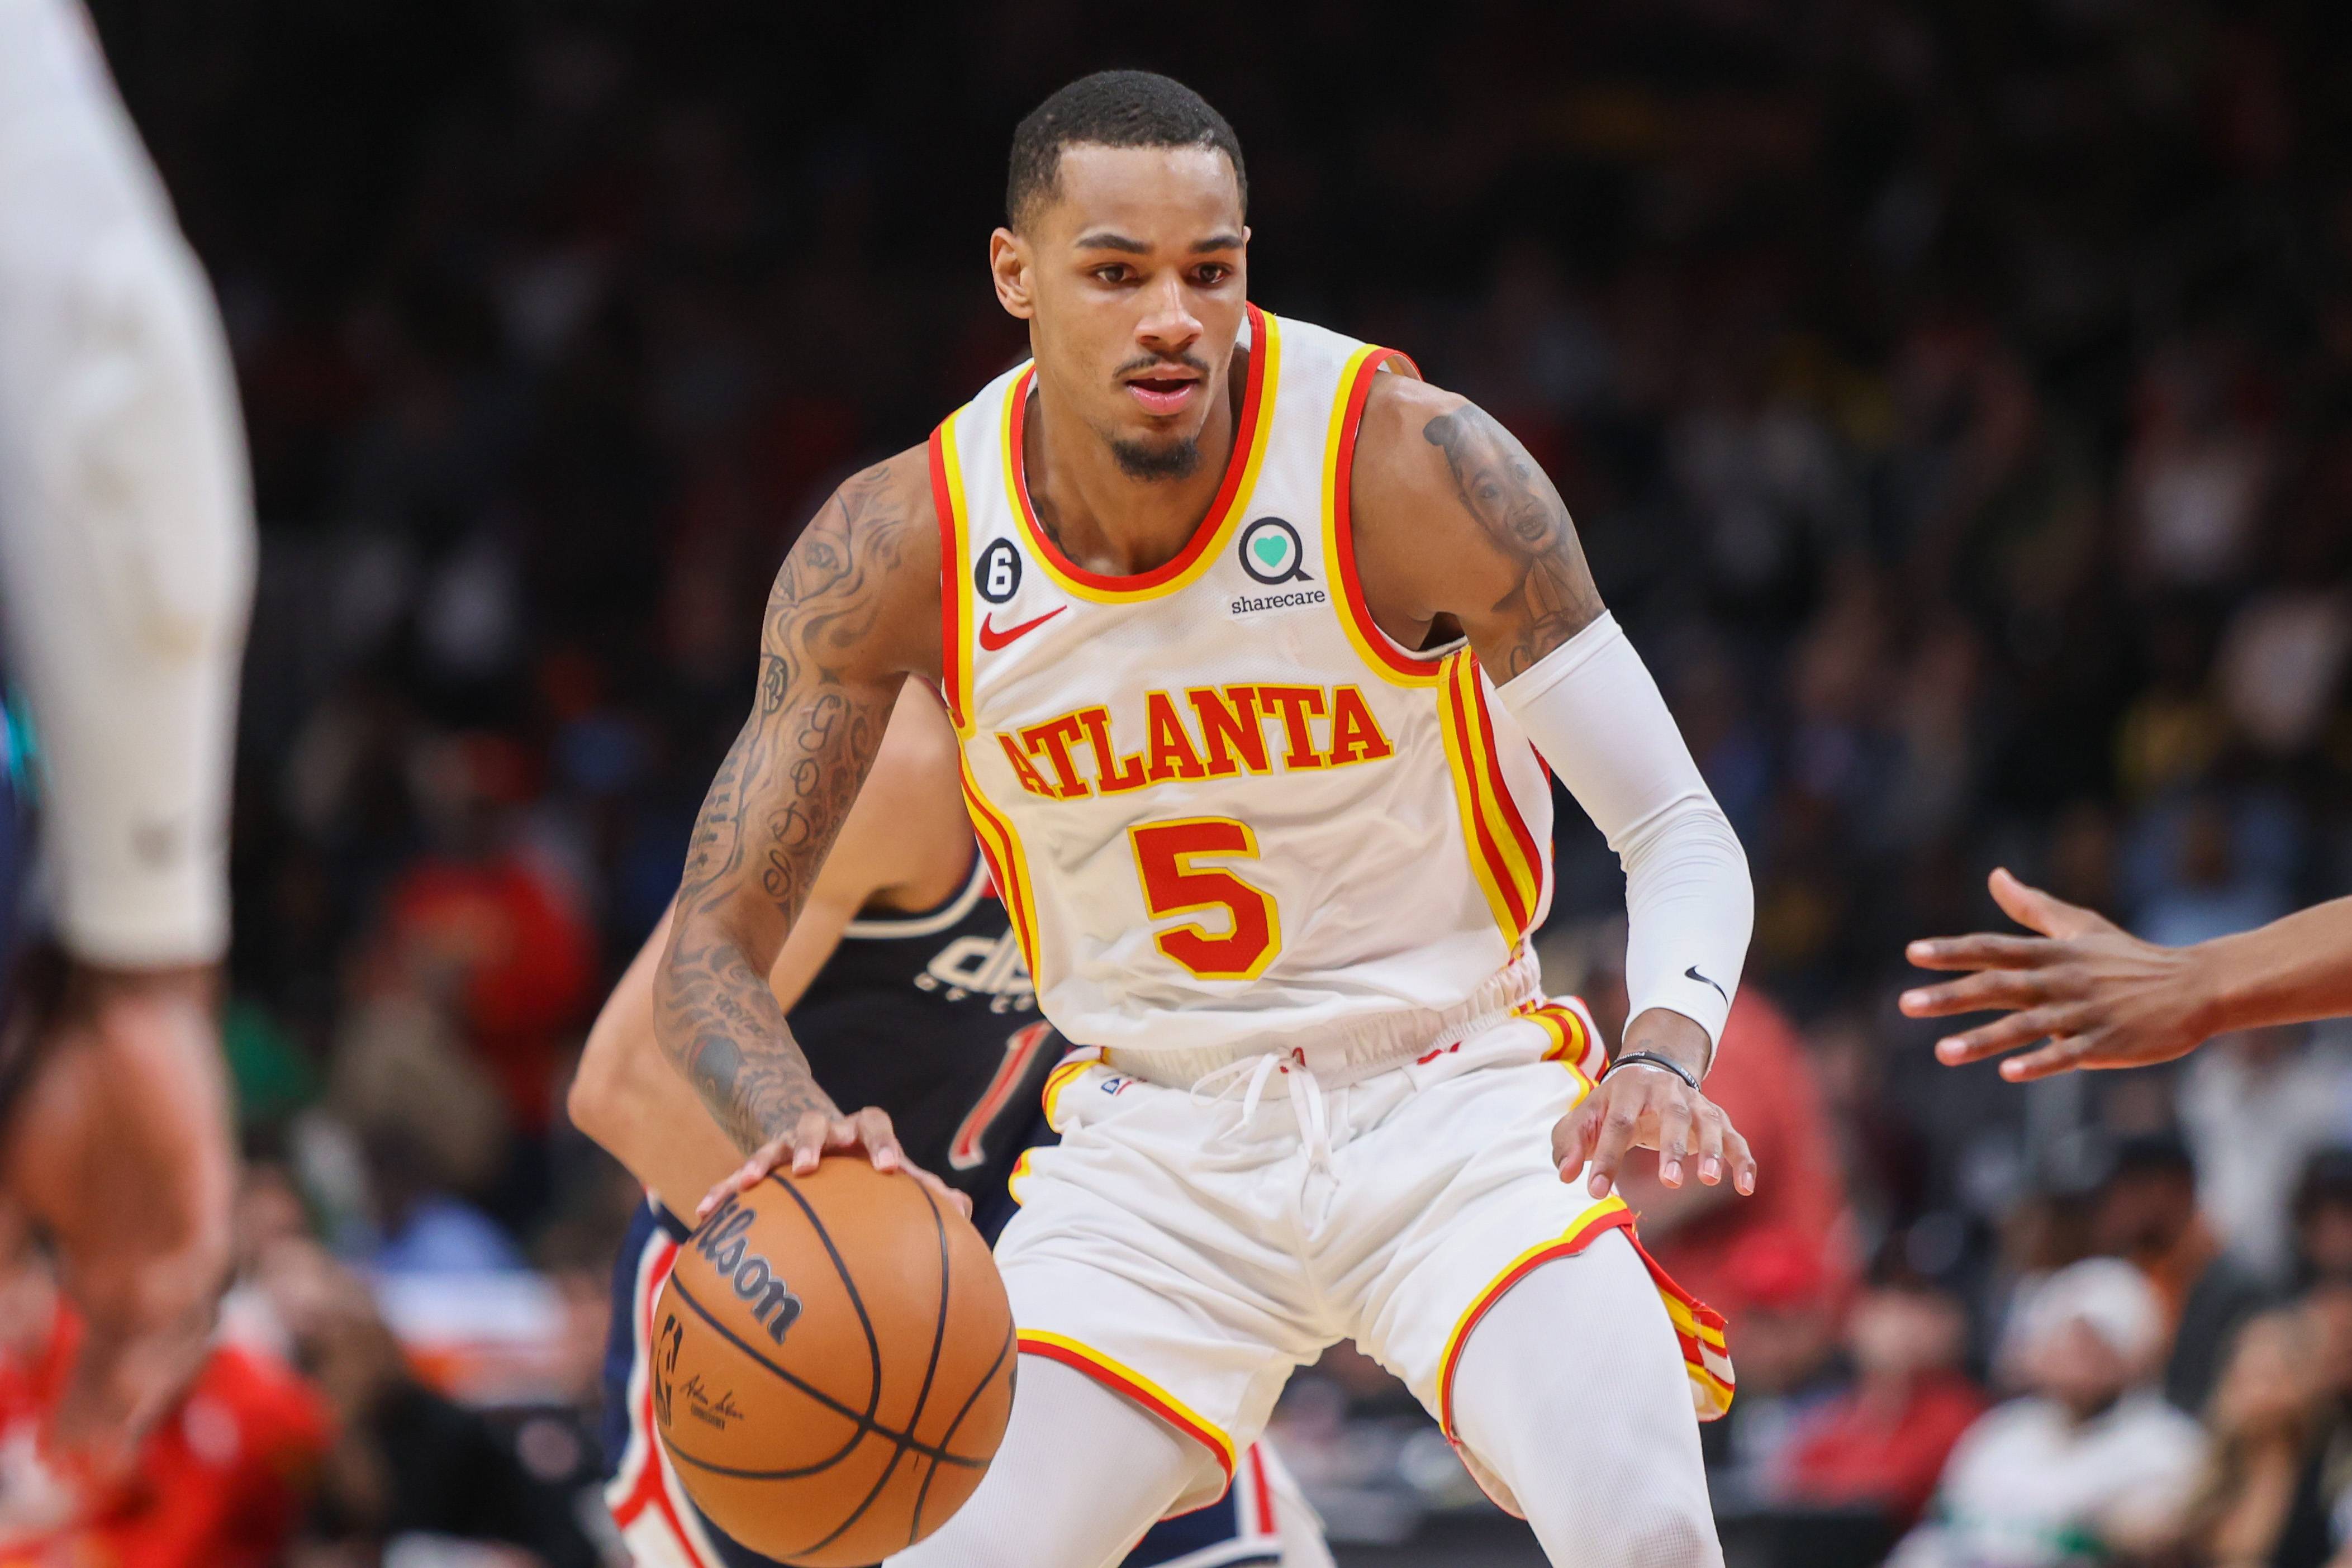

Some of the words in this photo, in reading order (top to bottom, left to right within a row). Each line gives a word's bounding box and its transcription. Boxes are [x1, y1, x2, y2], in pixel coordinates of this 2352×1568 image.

[987, 547, 1011, 596] 6
[1231, 590, 1325, 614] sharecare
[994, 683, 1394, 801] ATLANTA
[1127, 815, 1282, 980] 5
[948, 1019, 1054, 1171] 1
